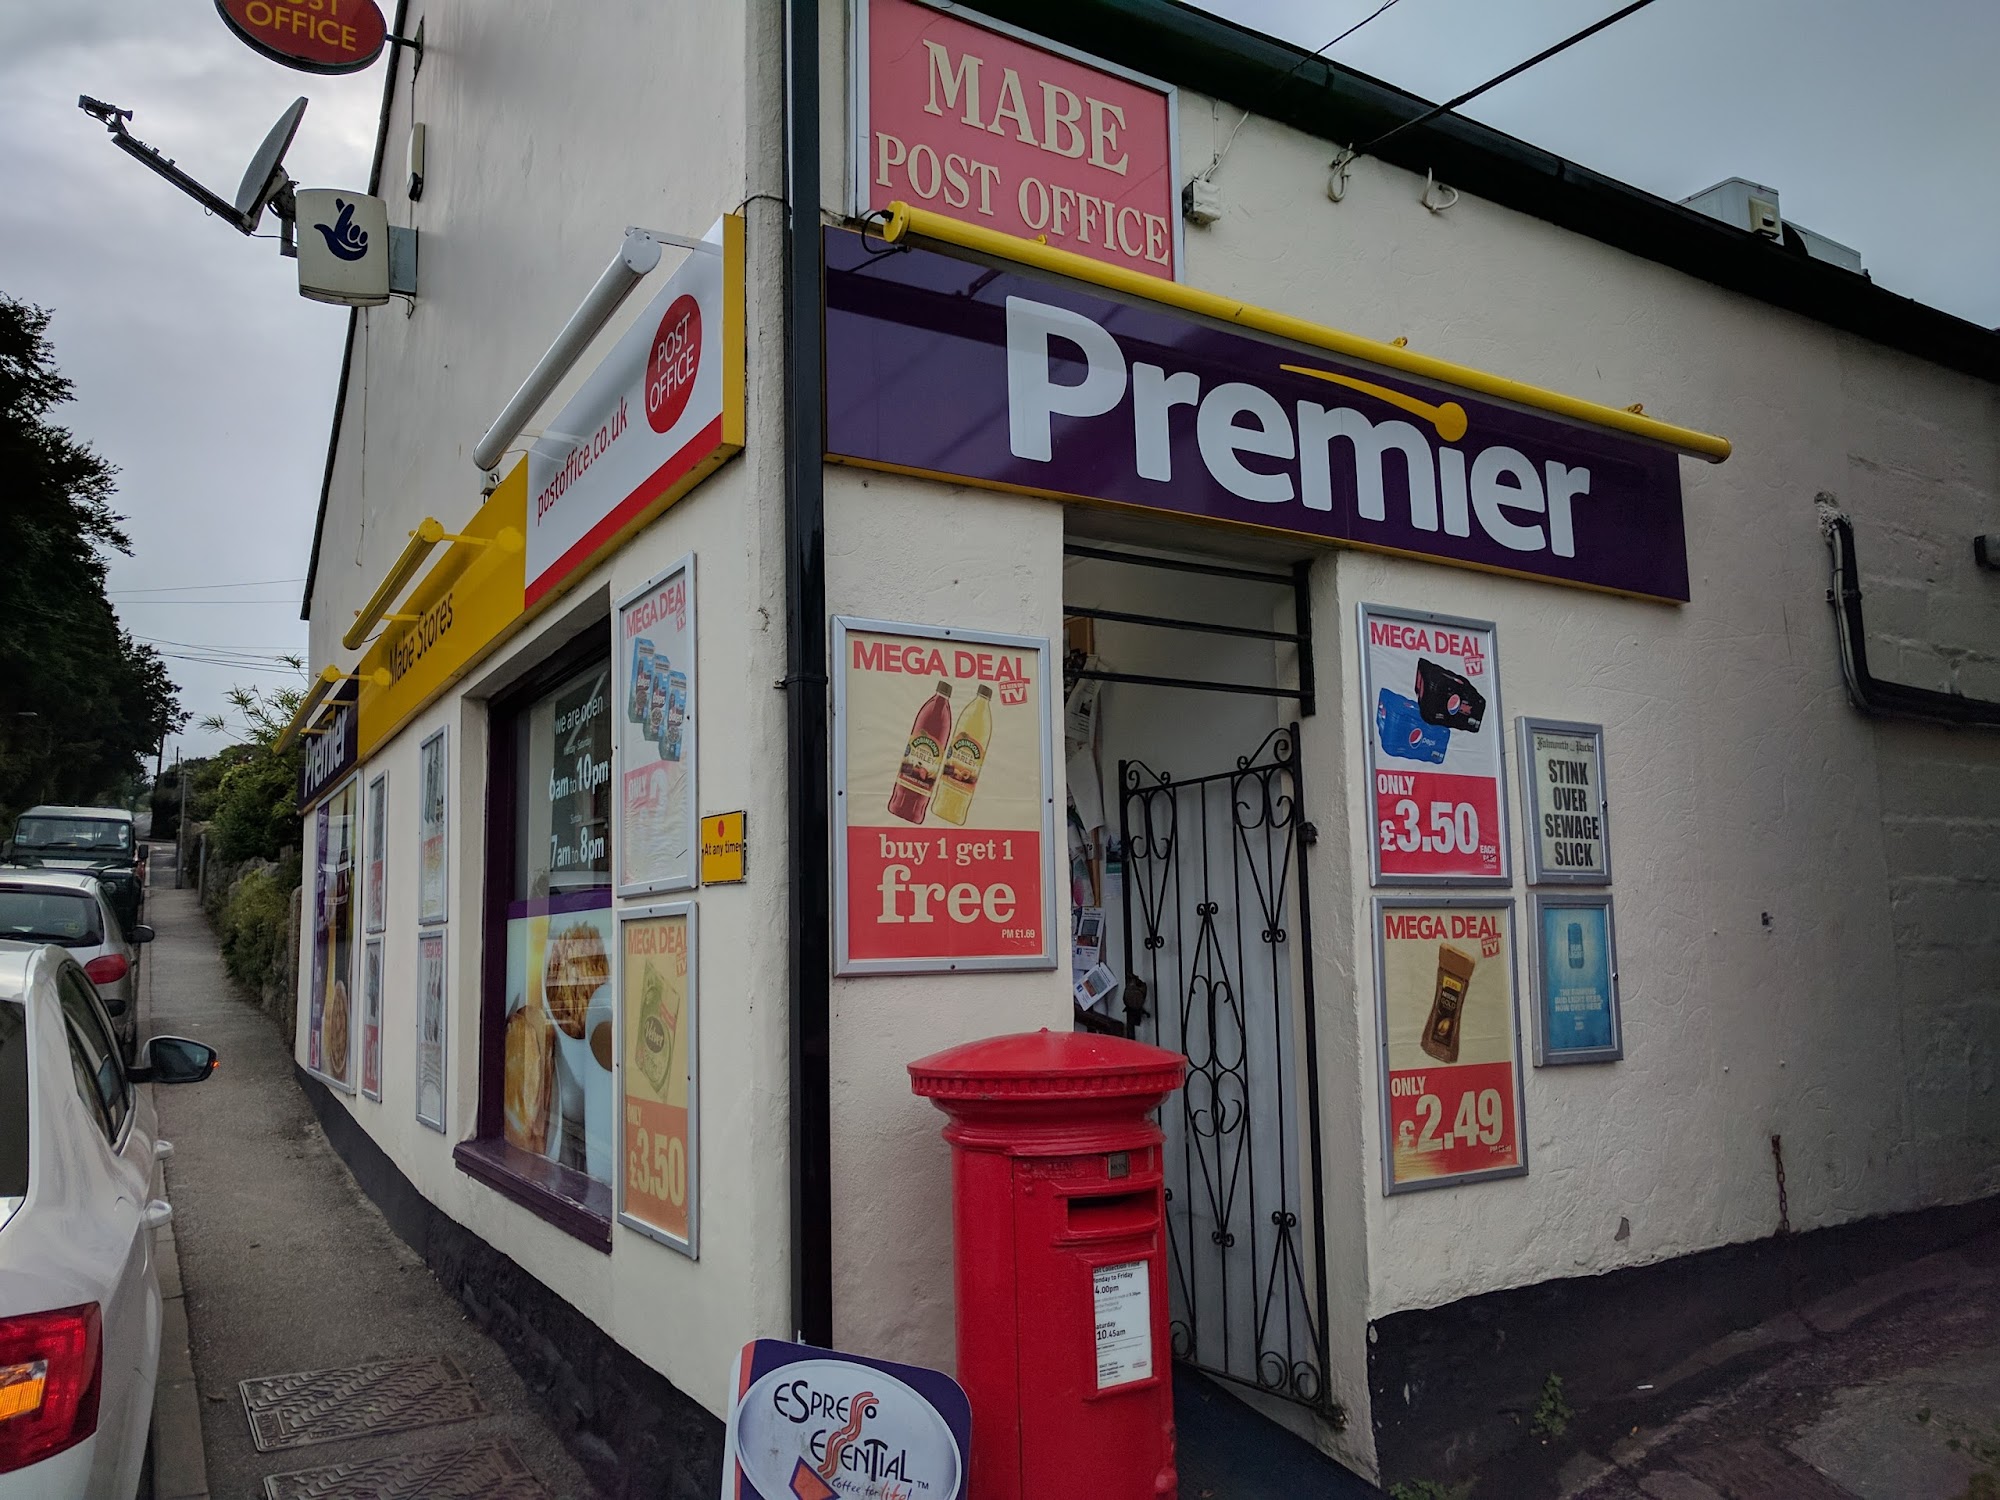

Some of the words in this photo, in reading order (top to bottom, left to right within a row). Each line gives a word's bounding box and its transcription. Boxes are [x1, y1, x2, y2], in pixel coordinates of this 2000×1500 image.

[245, 1, 357, 51] OFFICE
[922, 38, 1129, 177] MABE
[875, 131, 1000, 216] POST
[1017, 176, 1170, 267] OFFICE
[657, 312, 691, 372] POST
[649, 343, 695, 413] OFFICE
[1006, 294, 1592, 559] Premier
[537, 396, 629, 527] postoffice.co.uk
[625, 600, 658, 639] MEGA
[388, 632, 415, 690] Mabe
[416, 592, 454, 659] Stores
[1370, 621, 1431, 653] MEGA
[1434, 631, 1485, 659] DEAL
[853, 640, 949, 678] MEGA
[954, 650, 1031, 685] DEAL
[1466, 661, 1482, 674] TV
[1001, 687, 1025, 703] TV
[555, 715, 566, 736] we
[567, 707, 580, 731] are
[581, 695, 604, 728] open
[304, 705, 349, 799] Premier
[549, 768, 569, 802] 6am
[576, 753, 609, 796] 10pm
[1378, 773, 1415, 796] ONLY
[1548, 759, 1589, 785] STINK
[1552, 786, 1587, 812] OVER
[1380, 798, 1480, 854] £3.50
[1545, 813, 1600, 840] SEWAGE
[551, 834, 570, 869] 7am
[580, 826, 605, 870] 8pm
[704, 842, 712, 856] At
[712, 843, 724, 857] any
[724, 839, 740, 853] time
[879, 834, 930, 866] buy
[937, 837, 949, 859] 1
[956, 839, 997, 866] get
[1002, 839, 1014, 860] 1
[1554, 841, 1594, 867] SLICK
[876, 864, 1016, 924] free
[628, 927, 657, 956] MEGA
[1001, 929, 1014, 939] PM
[1385, 915, 1448, 940] MEGA
[1451, 915, 1502, 939] DEAL
[1483, 941, 1498, 956] TV
[1391, 1076, 1427, 1097] ONLY
[1398, 1088, 1504, 1155] £2.49
[629, 1127, 685, 1207] £3.50
[1095, 1285, 1119, 1294] 4.00pm
[1117, 1272, 1134, 1280] Friday
[1096, 1320, 1116, 1330] aturday
[1096, 1329, 1126, 1341] 10.45am
[831, 1477, 861, 1494] Coffee
[865, 1485, 880, 1497] for
